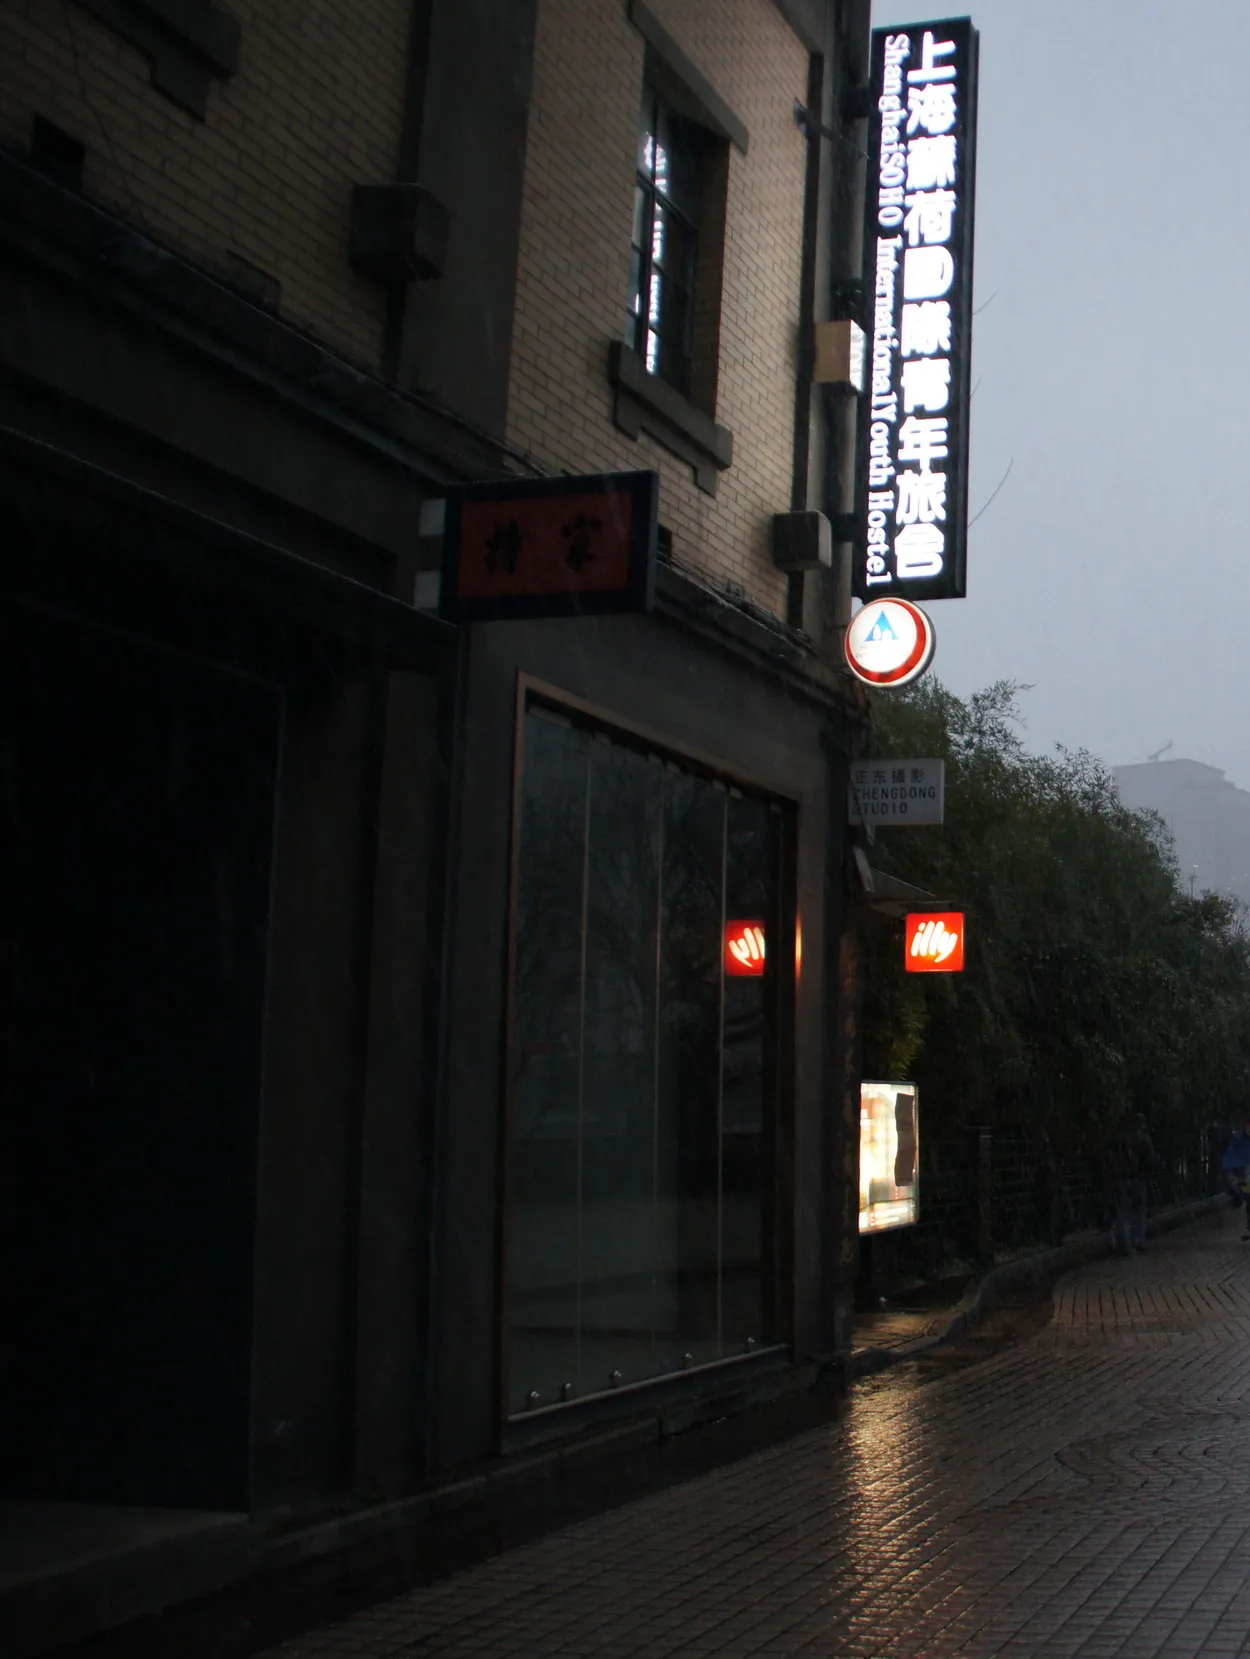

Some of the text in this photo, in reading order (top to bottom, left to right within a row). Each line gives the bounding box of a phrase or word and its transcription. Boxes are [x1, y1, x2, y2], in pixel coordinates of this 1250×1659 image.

[865, 489, 895, 588] Hostel
[853, 787, 936, 800] ZHENGDONG
[852, 802, 908, 815] STUDIO
[911, 921, 958, 963] illy
